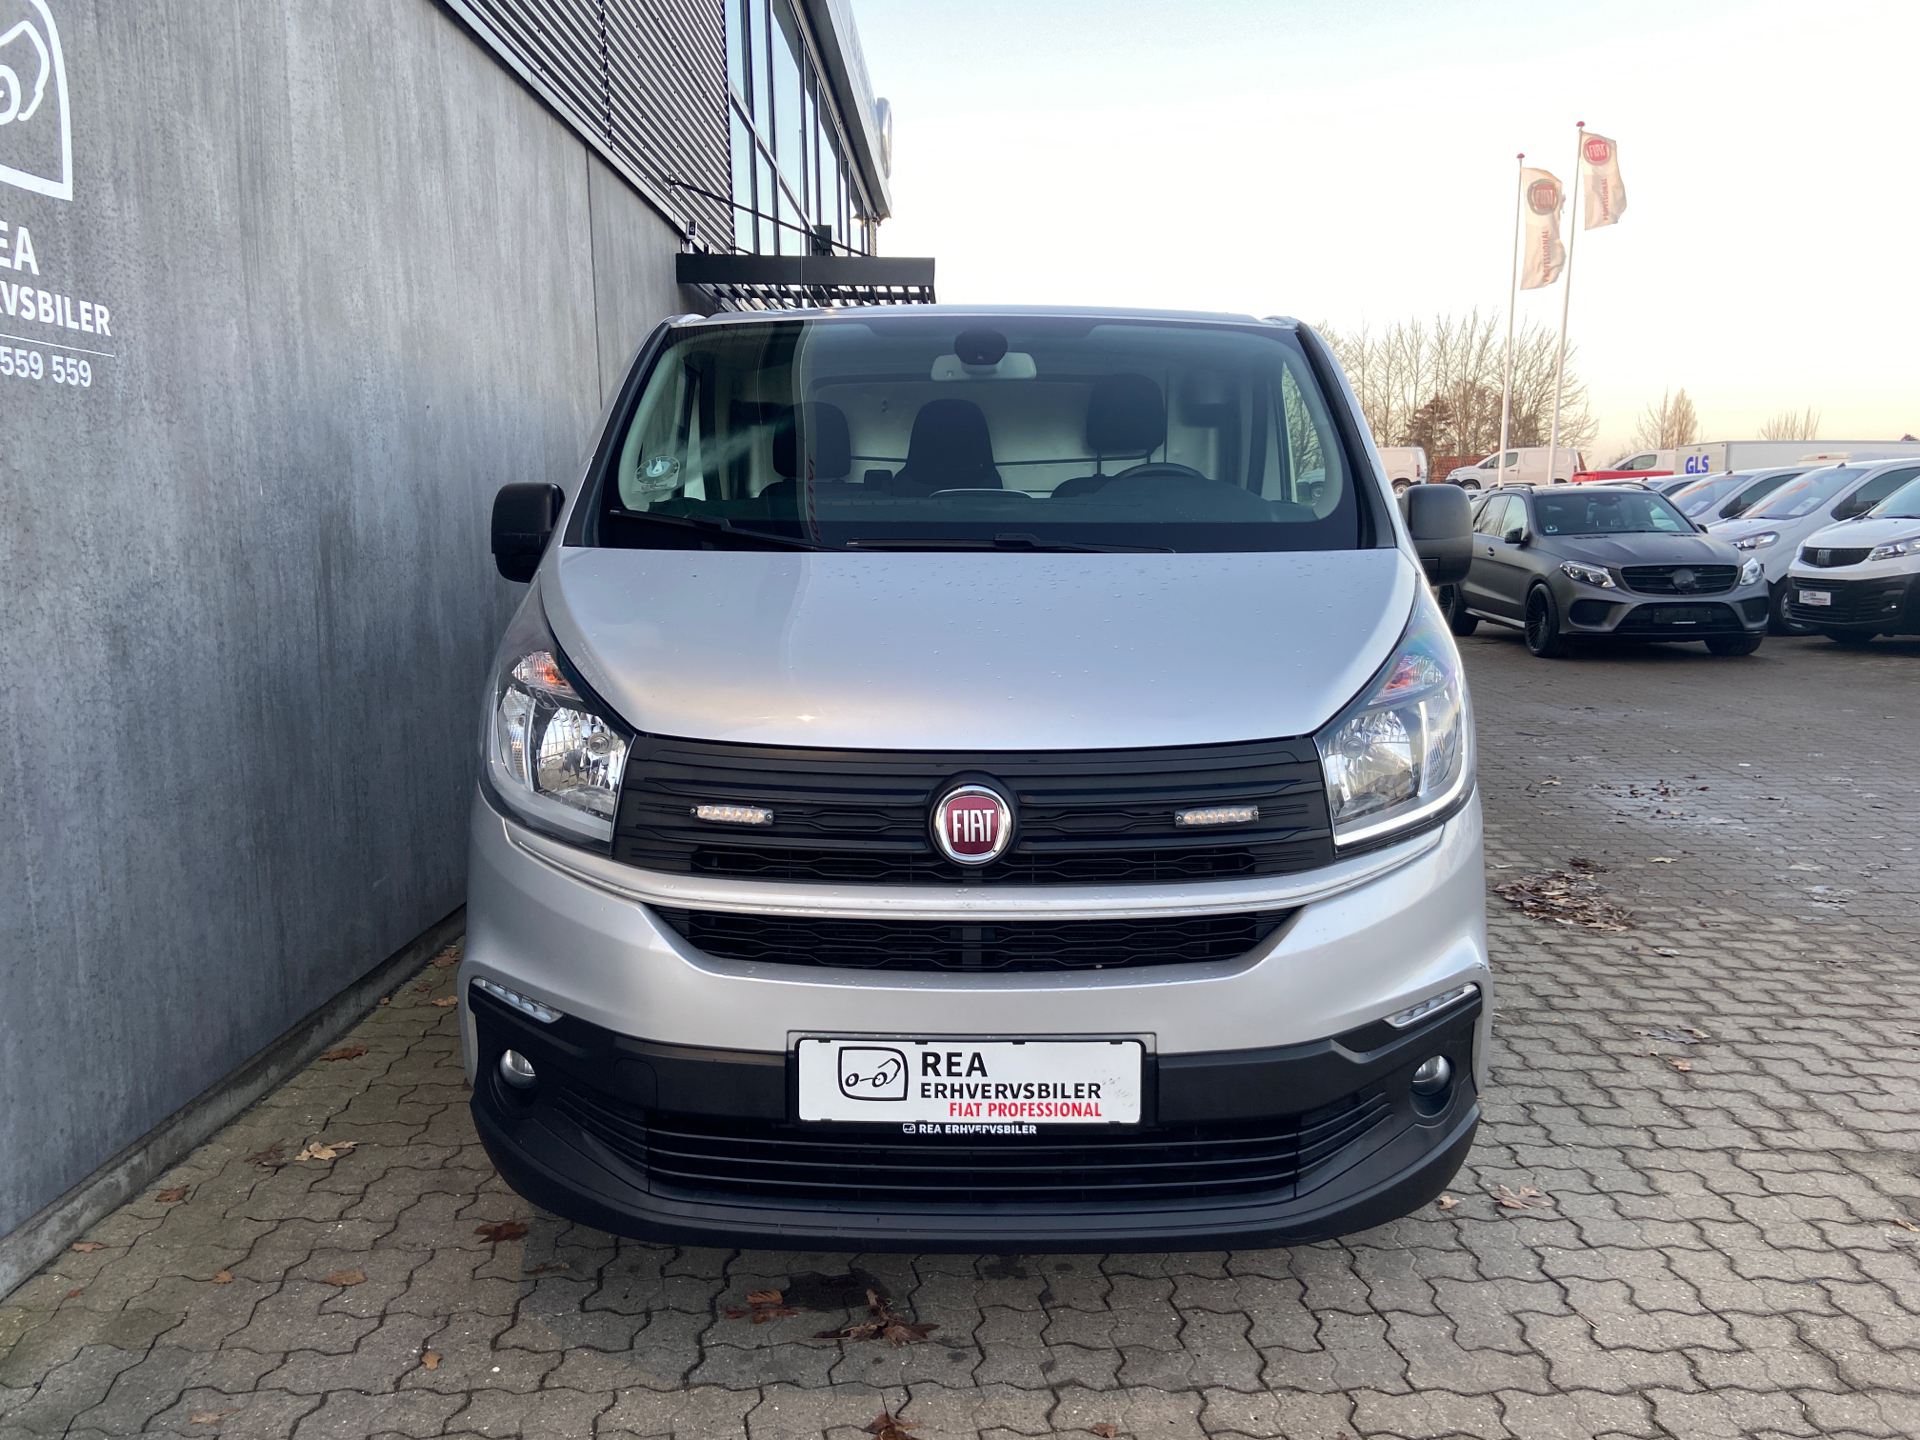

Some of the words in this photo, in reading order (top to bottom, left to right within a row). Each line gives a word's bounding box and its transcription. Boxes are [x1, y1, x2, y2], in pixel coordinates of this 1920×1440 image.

[1588, 144, 1606, 158] FIAT
[1536, 189, 1554, 205] FIAT
[0, 280, 112, 337] VSBILER
[0, 346, 44, 380] 559
[52, 354, 92, 388] 559
[952, 809, 994, 842] FIAT
[921, 1051, 988, 1077] REA
[920, 1082, 1102, 1100] ERHVERVSBILER
[949, 1102, 983, 1118] FIAT
[988, 1102, 1102, 1118] PROFESSIONAL
[919, 1124, 942, 1134] REA
